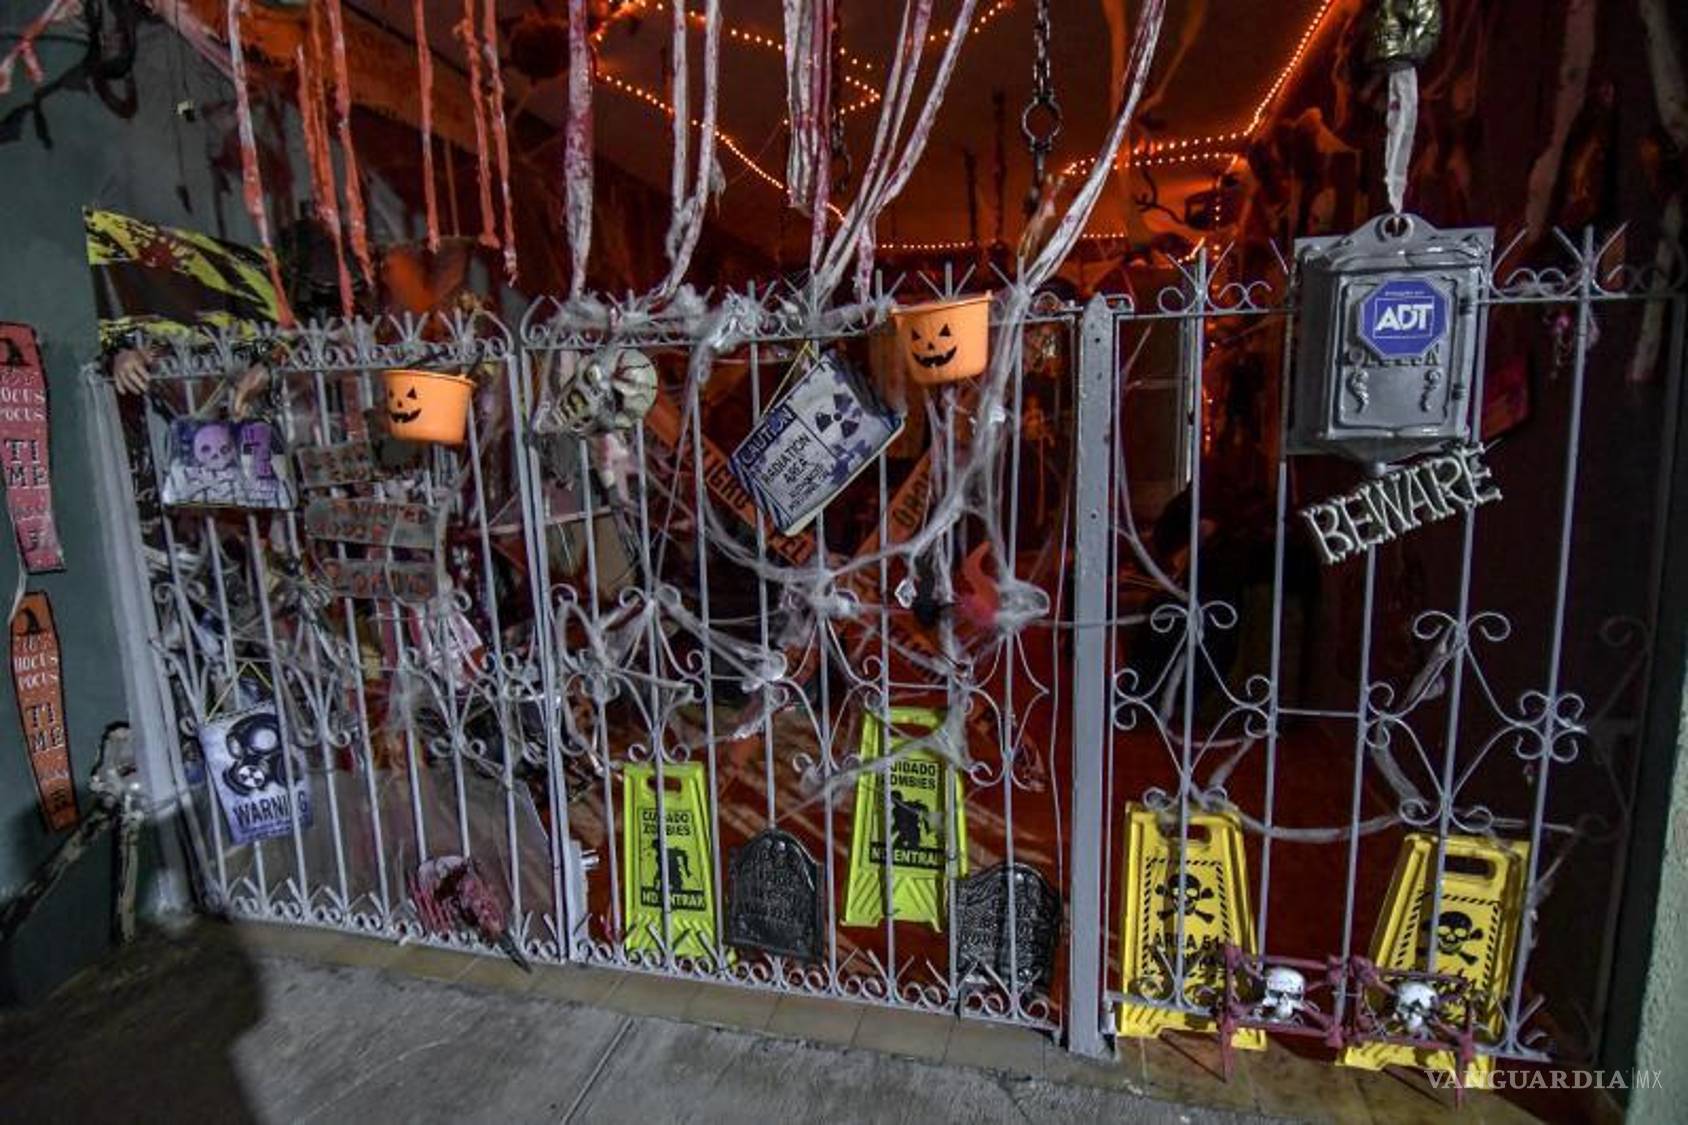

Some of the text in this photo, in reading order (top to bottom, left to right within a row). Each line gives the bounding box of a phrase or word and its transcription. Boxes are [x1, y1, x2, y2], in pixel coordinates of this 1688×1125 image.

[1375, 303, 1434, 331] ADT
[0, 386, 46, 403] OCUS
[740, 403, 796, 465] CAUTON
[1301, 442, 1503, 564] BEWARE
[889, 760, 936, 777] UIDADO
[889, 774, 936, 790] OMBIES
[233, 790, 307, 827] WARNIG
[642, 811, 690, 824] CUADO
[642, 823, 690, 836] ZOBIES
[669, 892, 705, 908] NTRAR
